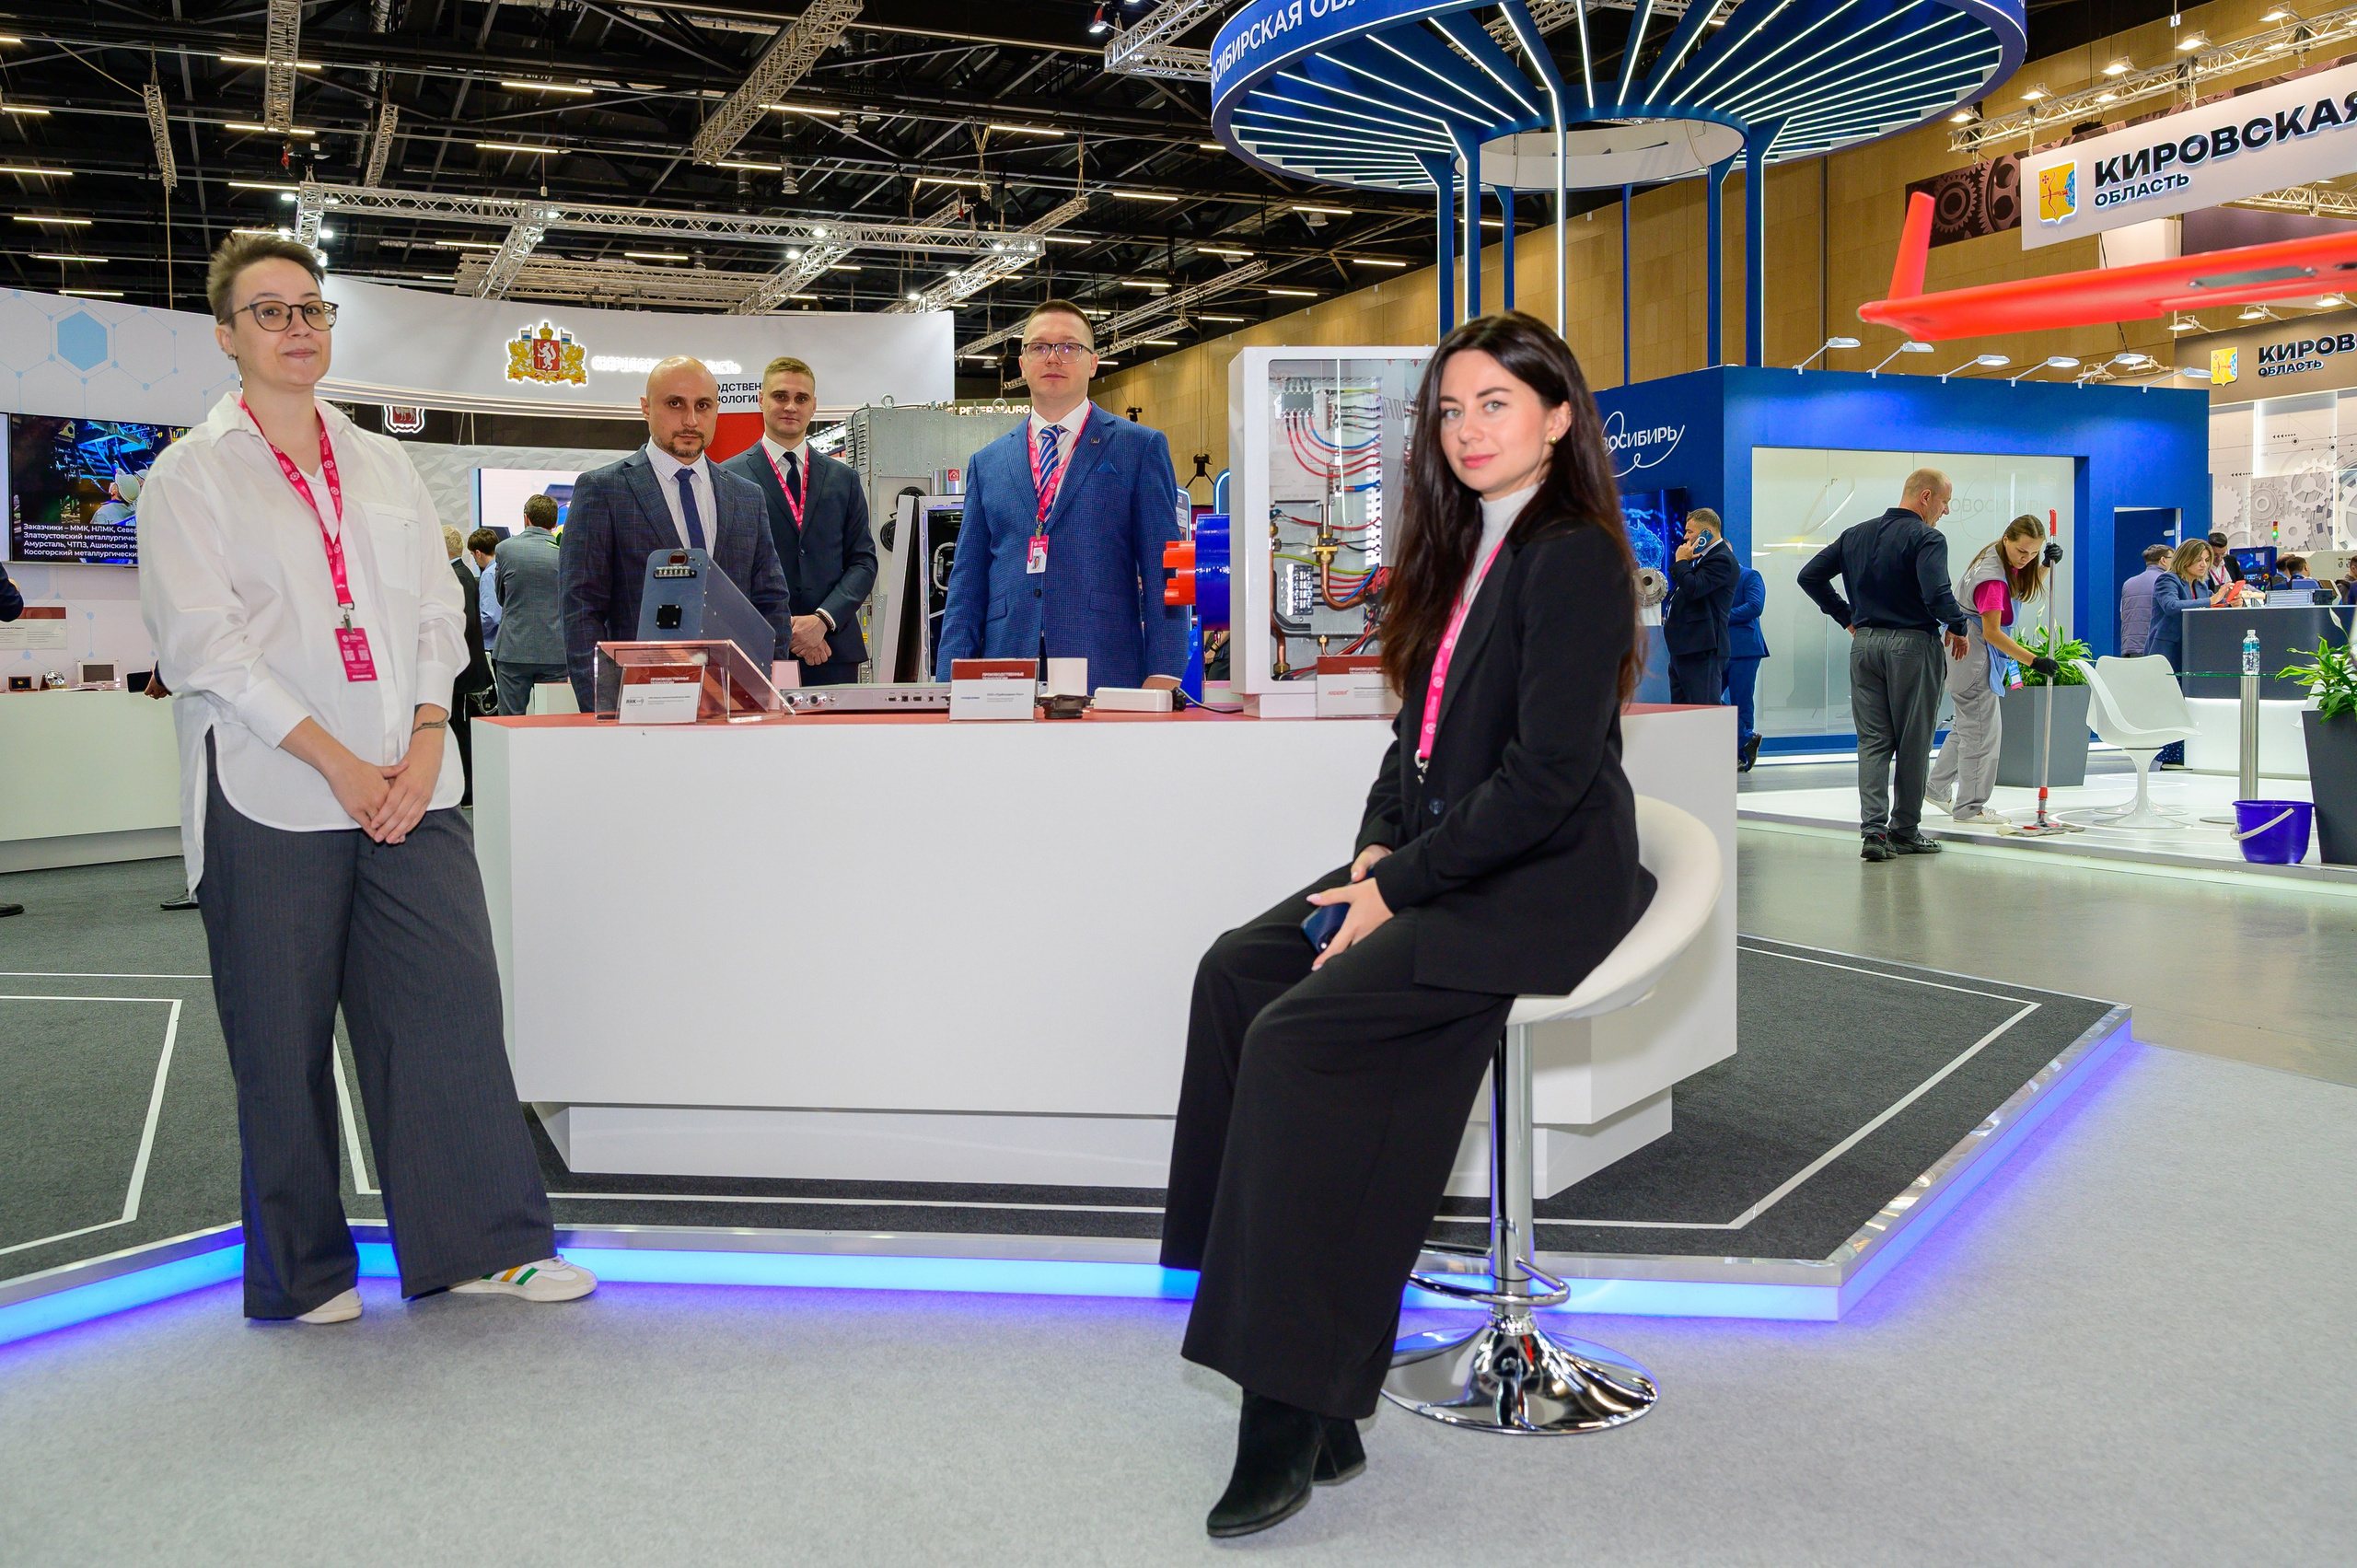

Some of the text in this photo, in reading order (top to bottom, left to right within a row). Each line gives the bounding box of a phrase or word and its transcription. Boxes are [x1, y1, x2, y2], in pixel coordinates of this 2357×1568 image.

[2095, 90, 2357, 188] КИРОВСКАЯ
[2094, 173, 2190, 206] ОБЛАСТЬ
[2258, 360, 2324, 377] ОБЛАСТЬ
[23, 523, 63, 531] Заказчики
[23, 532, 83, 540] Златоустовский
[23, 540, 66, 549] Амурсталь,
[89, 541, 128, 550] Ашинский
[24, 548, 73, 557] Косогорский
